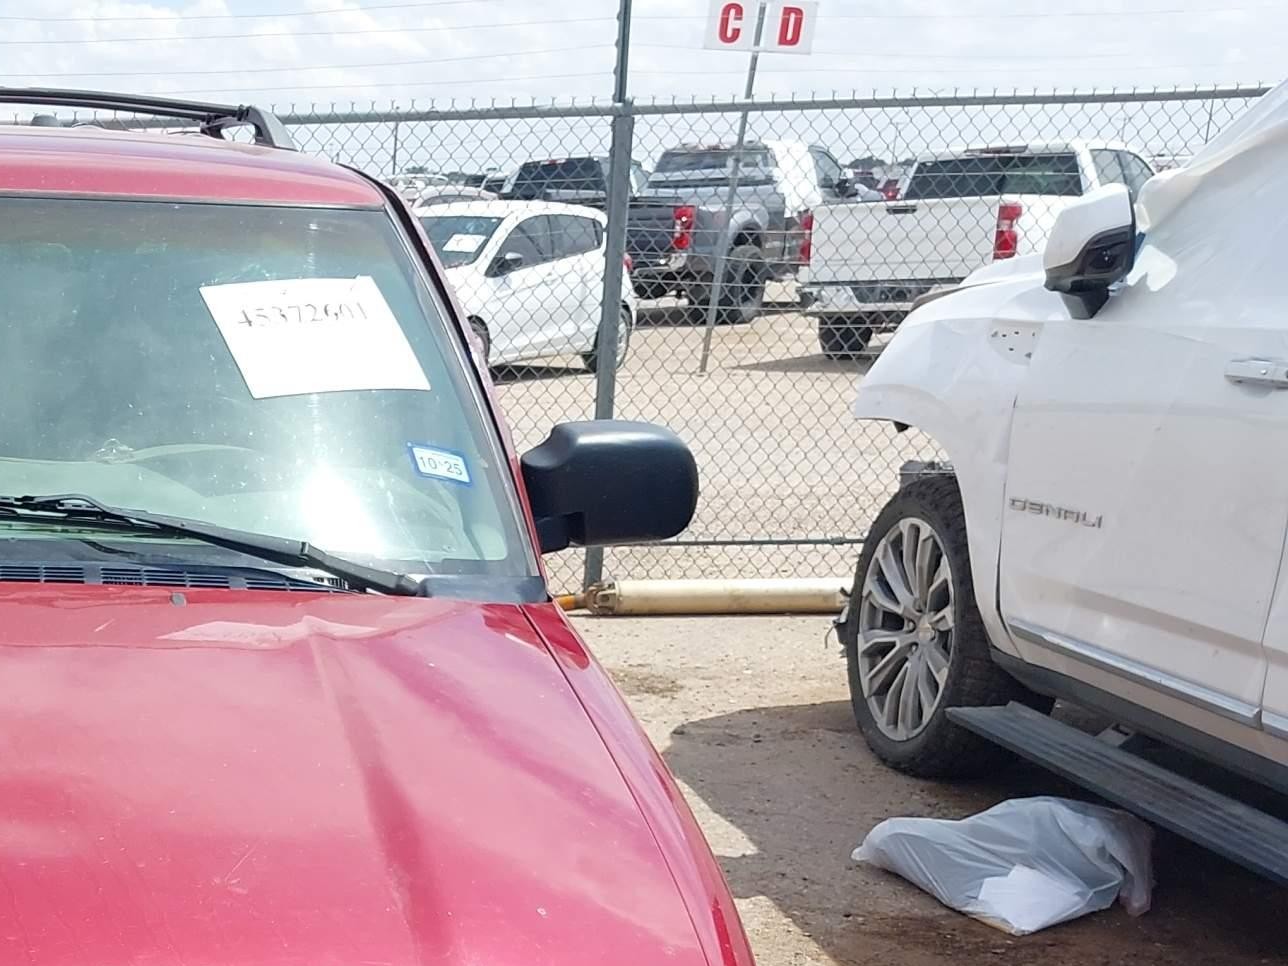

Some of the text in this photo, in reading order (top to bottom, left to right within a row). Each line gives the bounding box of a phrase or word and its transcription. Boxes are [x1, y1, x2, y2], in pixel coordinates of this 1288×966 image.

[718, 2, 744, 43] C
[777, 6, 804, 46] D
[1009, 497, 1104, 529] DENALI
